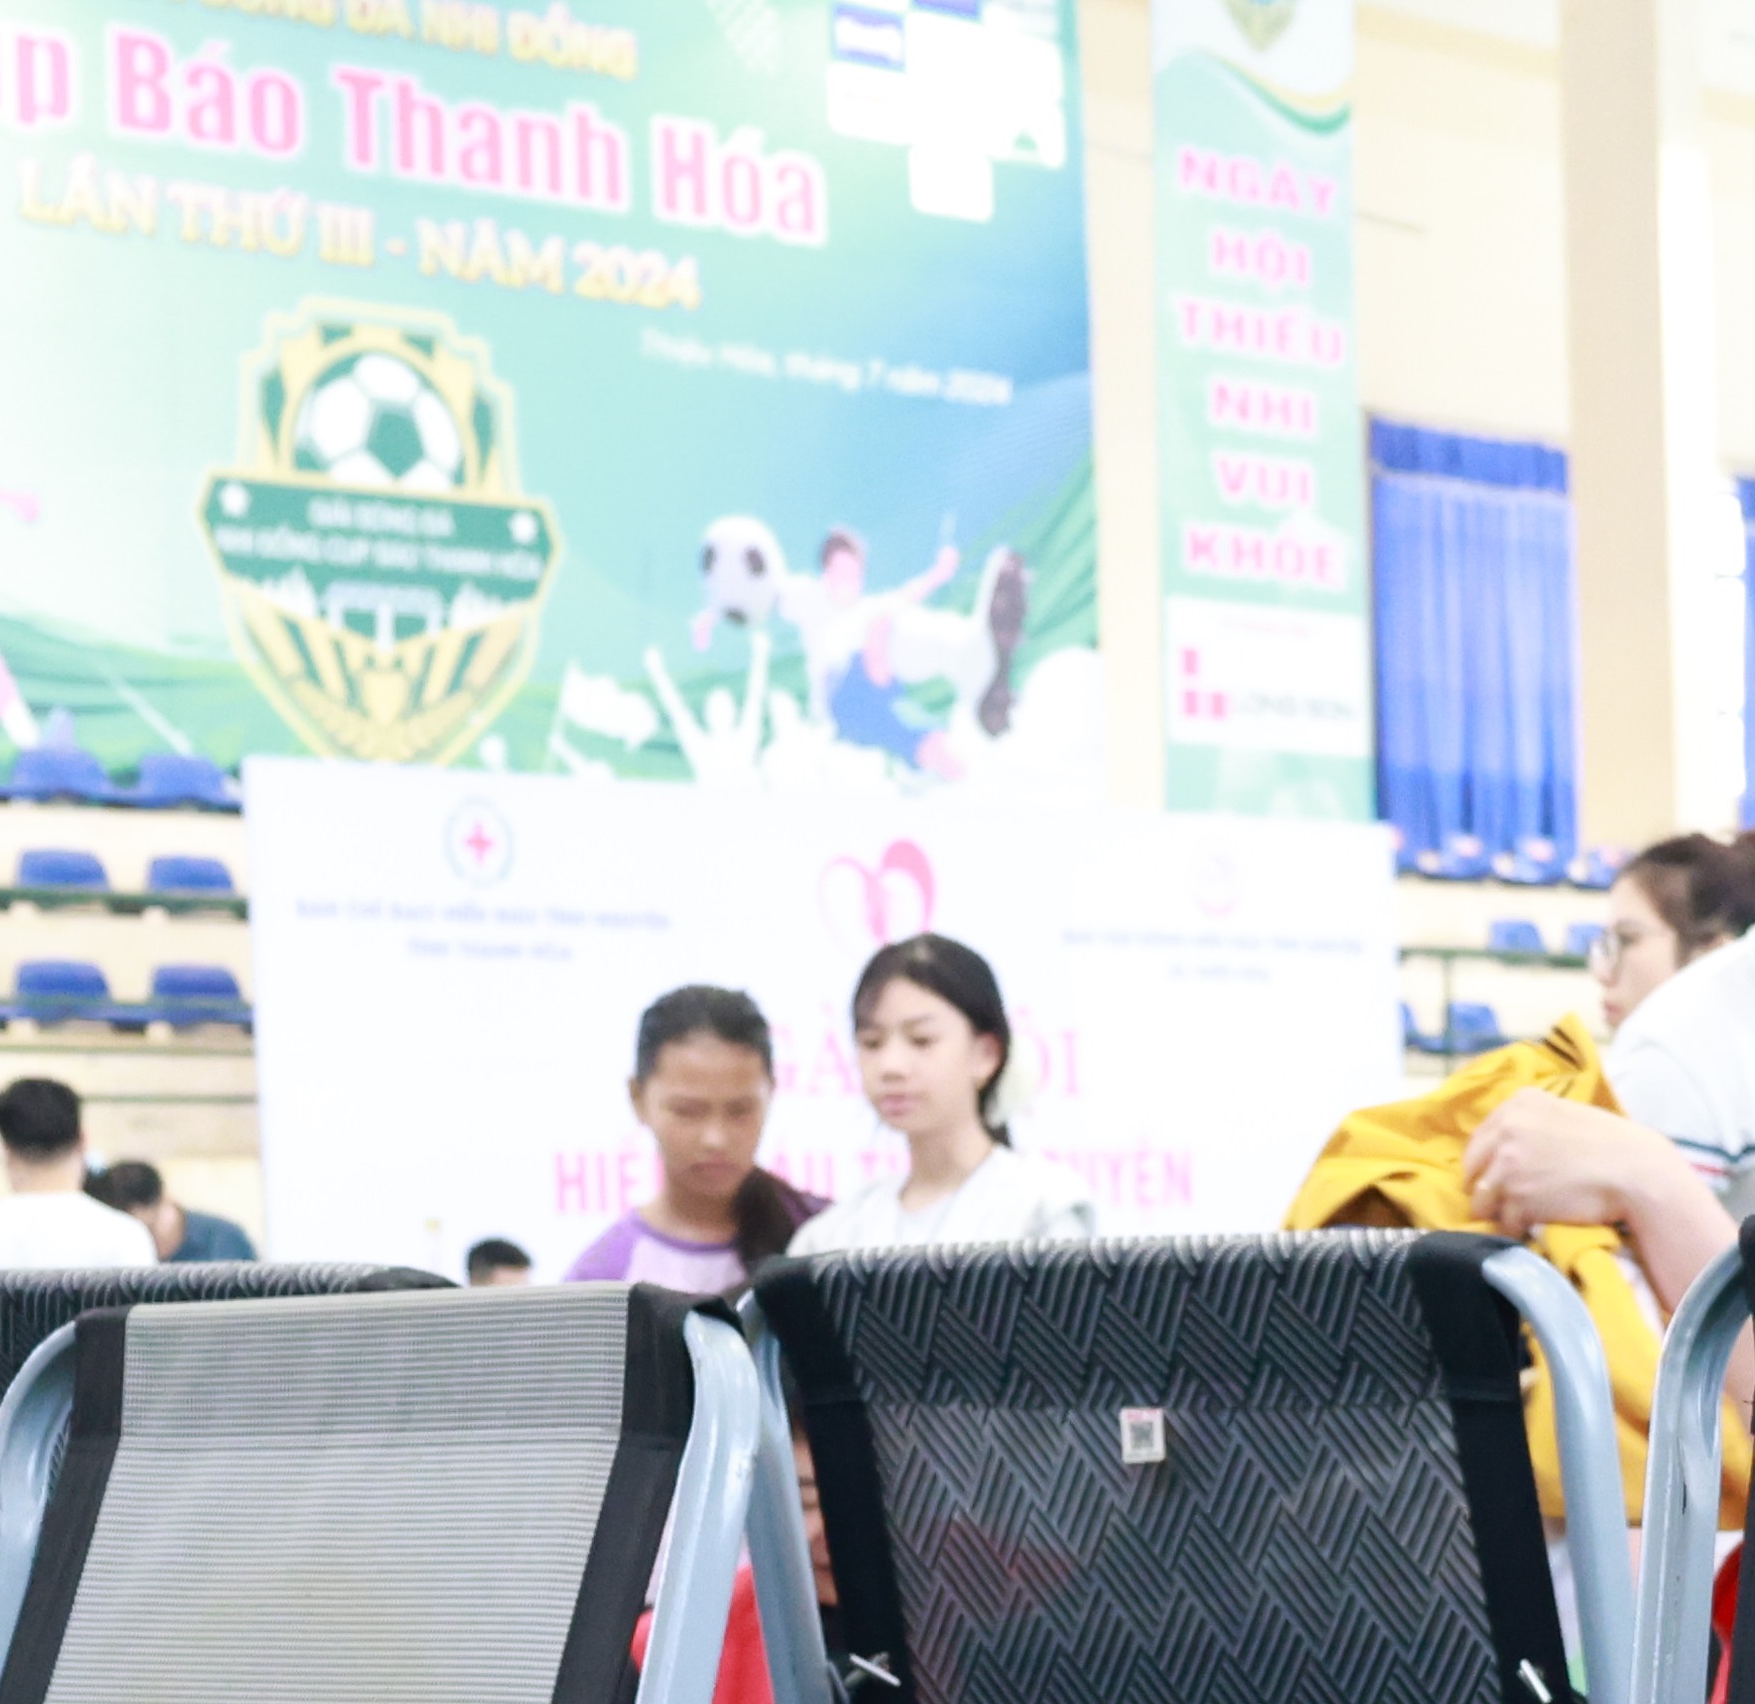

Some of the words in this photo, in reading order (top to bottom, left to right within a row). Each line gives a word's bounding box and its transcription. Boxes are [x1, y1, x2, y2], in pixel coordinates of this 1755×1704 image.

[113, 26, 303, 157] Báo
[332, 65, 624, 208] Thanh
[655, 122, 819, 238] Hóa
[315, 204, 376, 268] III
[572, 240, 701, 311] 2024
[1209, 380, 1315, 435] NHI
[1213, 457, 1315, 508] VUI
